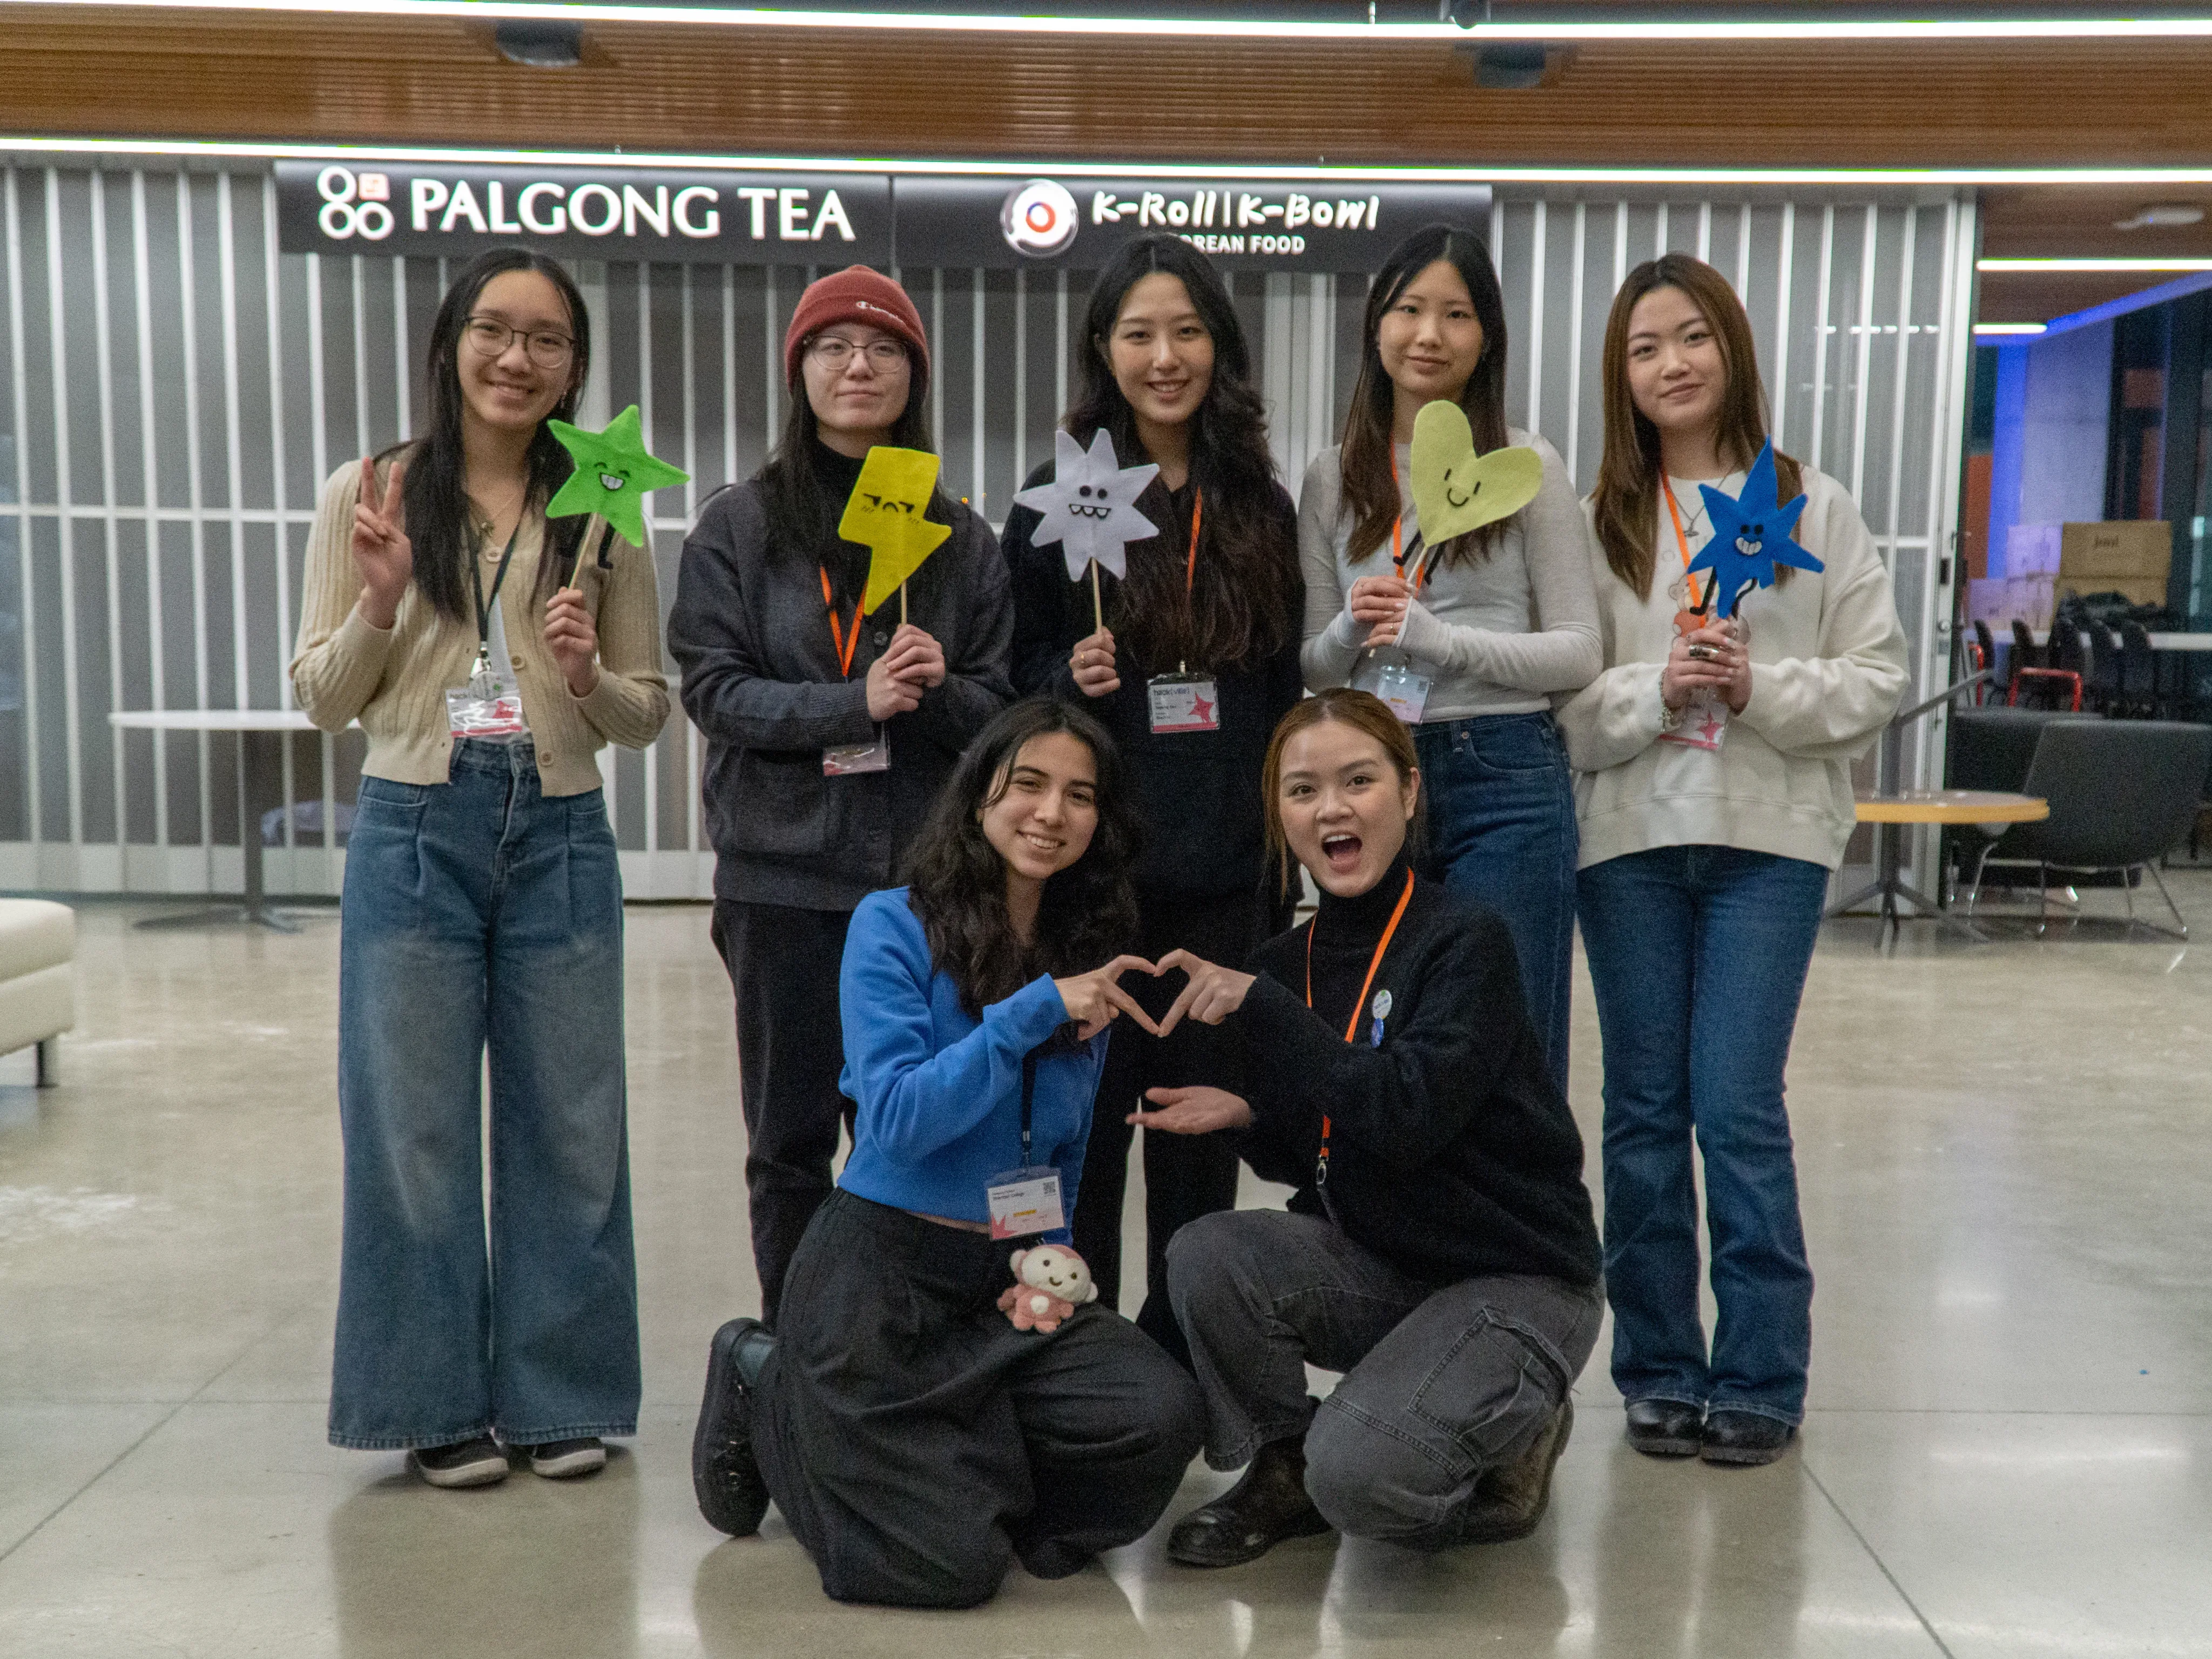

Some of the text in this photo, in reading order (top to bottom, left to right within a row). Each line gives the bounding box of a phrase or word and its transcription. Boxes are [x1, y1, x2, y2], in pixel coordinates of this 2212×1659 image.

[410, 178, 856, 241] PALGONG TEA
[1179, 234, 1305, 254] REAN FOOD
